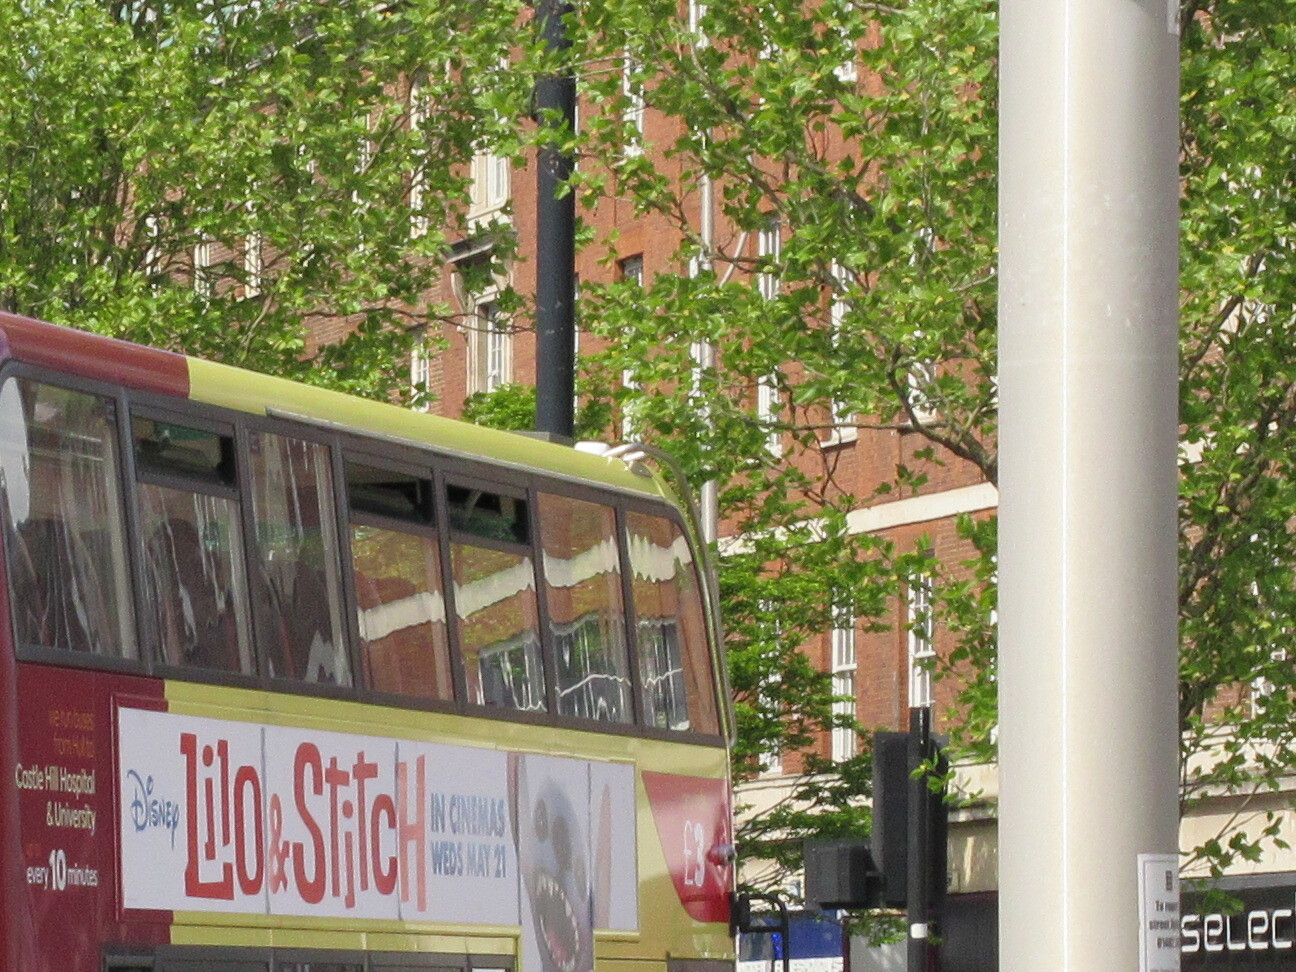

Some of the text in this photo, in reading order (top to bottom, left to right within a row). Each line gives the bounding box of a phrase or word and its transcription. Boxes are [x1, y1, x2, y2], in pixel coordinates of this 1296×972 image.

[15, 763, 44, 789] Castle
[60, 767, 96, 800] Hospital
[55, 802, 97, 837] University
[430, 792, 507, 838] IN CINEMAS
[268, 793, 290, 894] &
[431, 841, 464, 877] WEDS
[467, 843, 491, 878] MAY
[26, 866, 49, 890] every
[49, 849, 66, 892] 10
[68, 864, 99, 887] minutes
